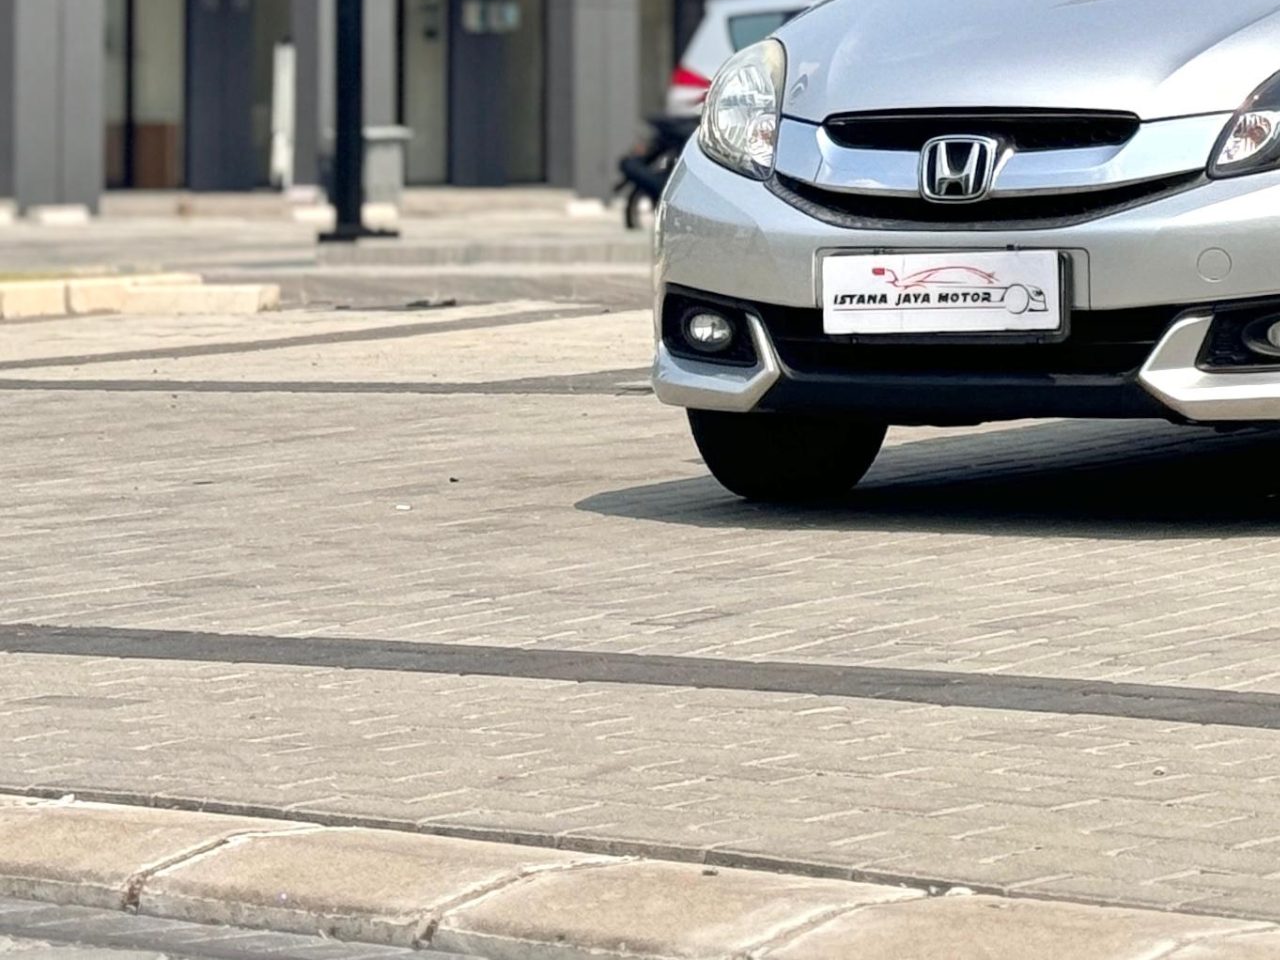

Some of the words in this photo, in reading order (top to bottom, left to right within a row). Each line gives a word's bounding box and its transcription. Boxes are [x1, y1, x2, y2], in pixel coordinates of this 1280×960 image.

[833, 293, 888, 305] ISTANA
[895, 293, 931, 306] JAYA
[937, 292, 992, 303] MOTOR
